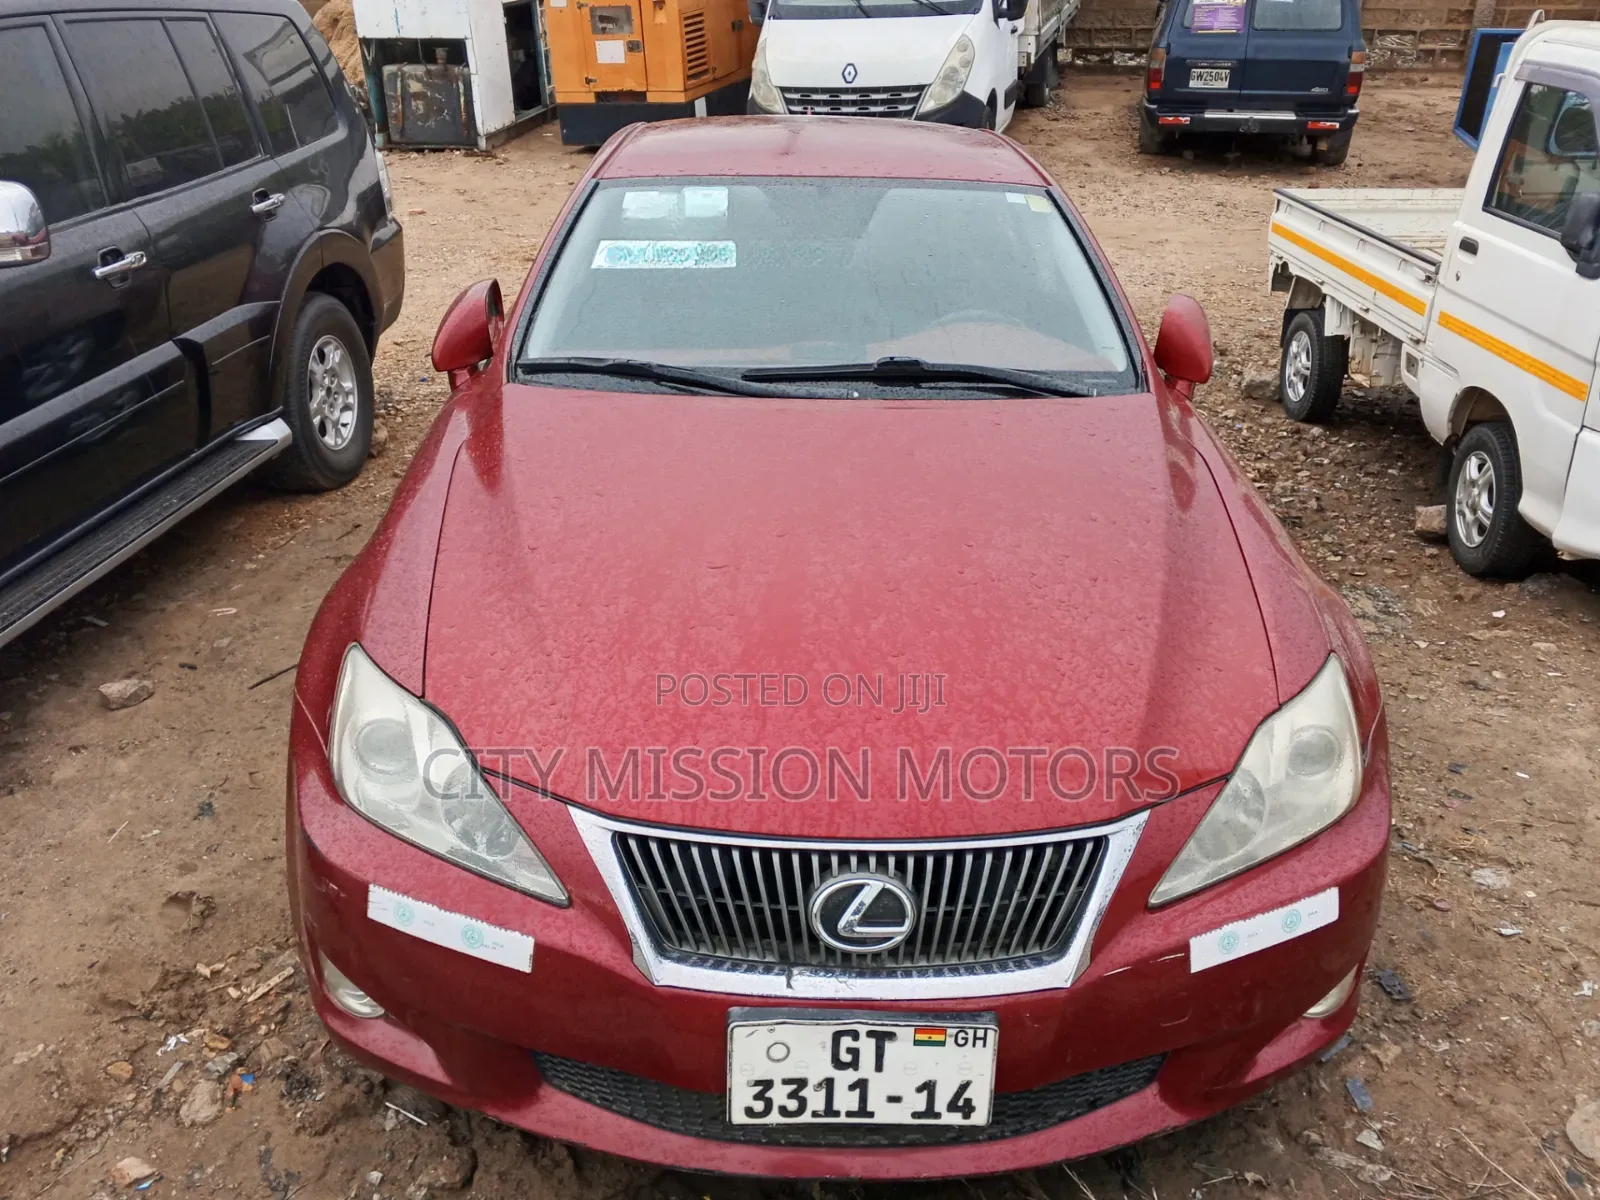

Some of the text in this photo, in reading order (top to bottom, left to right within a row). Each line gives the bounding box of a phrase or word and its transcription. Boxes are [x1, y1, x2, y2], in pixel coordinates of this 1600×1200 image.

[831, 1029, 988, 1072] GT GH
[744, 1077, 977, 1120] 3311-14
